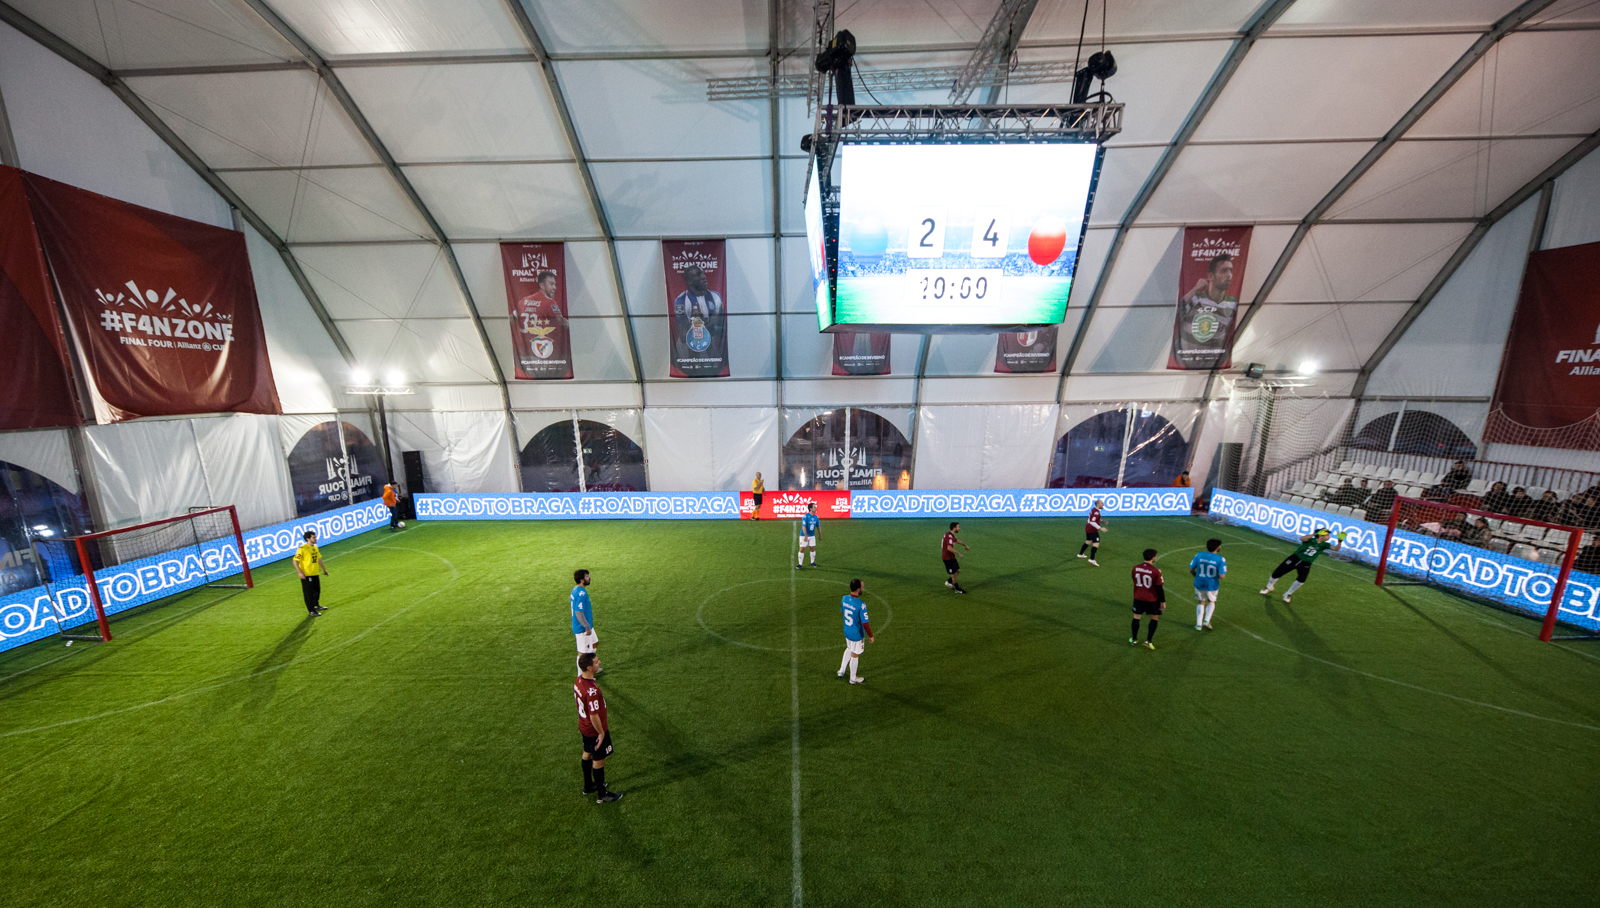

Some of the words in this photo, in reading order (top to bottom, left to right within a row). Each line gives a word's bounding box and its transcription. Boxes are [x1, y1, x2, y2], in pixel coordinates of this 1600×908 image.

[919, 217, 936, 247] 2
[982, 218, 999, 247] 4
[100, 309, 235, 342] #F4NZONE
[120, 336, 148, 347] FINAL
[148, 338, 173, 349] FOUR
[177, 342, 202, 350] Allianz
[1555, 349, 1600, 364] FINA
[416, 498, 575, 516] #ROADTOBRAGA
[578, 496, 739, 514] #ROADTOBRAGA
[853, 493, 1016, 513] #ROADTOBRAGA
[244, 503, 392, 562] #ROADTOBRAGA
[1210, 494, 1379, 557] #ROADTOBRAGA
[1135, 573, 1152, 589] 10
[1199, 564, 1217, 578] 10
[1387, 536, 1600, 621] #ROADTOB
[0, 543, 242, 641] OADTOBRAGA
[578, 602, 583, 610] 4
[844, 609, 854, 626] 5
[574, 693, 587, 719] 8
[589, 699, 599, 712] 18
[606, 744, 612, 754] 18
